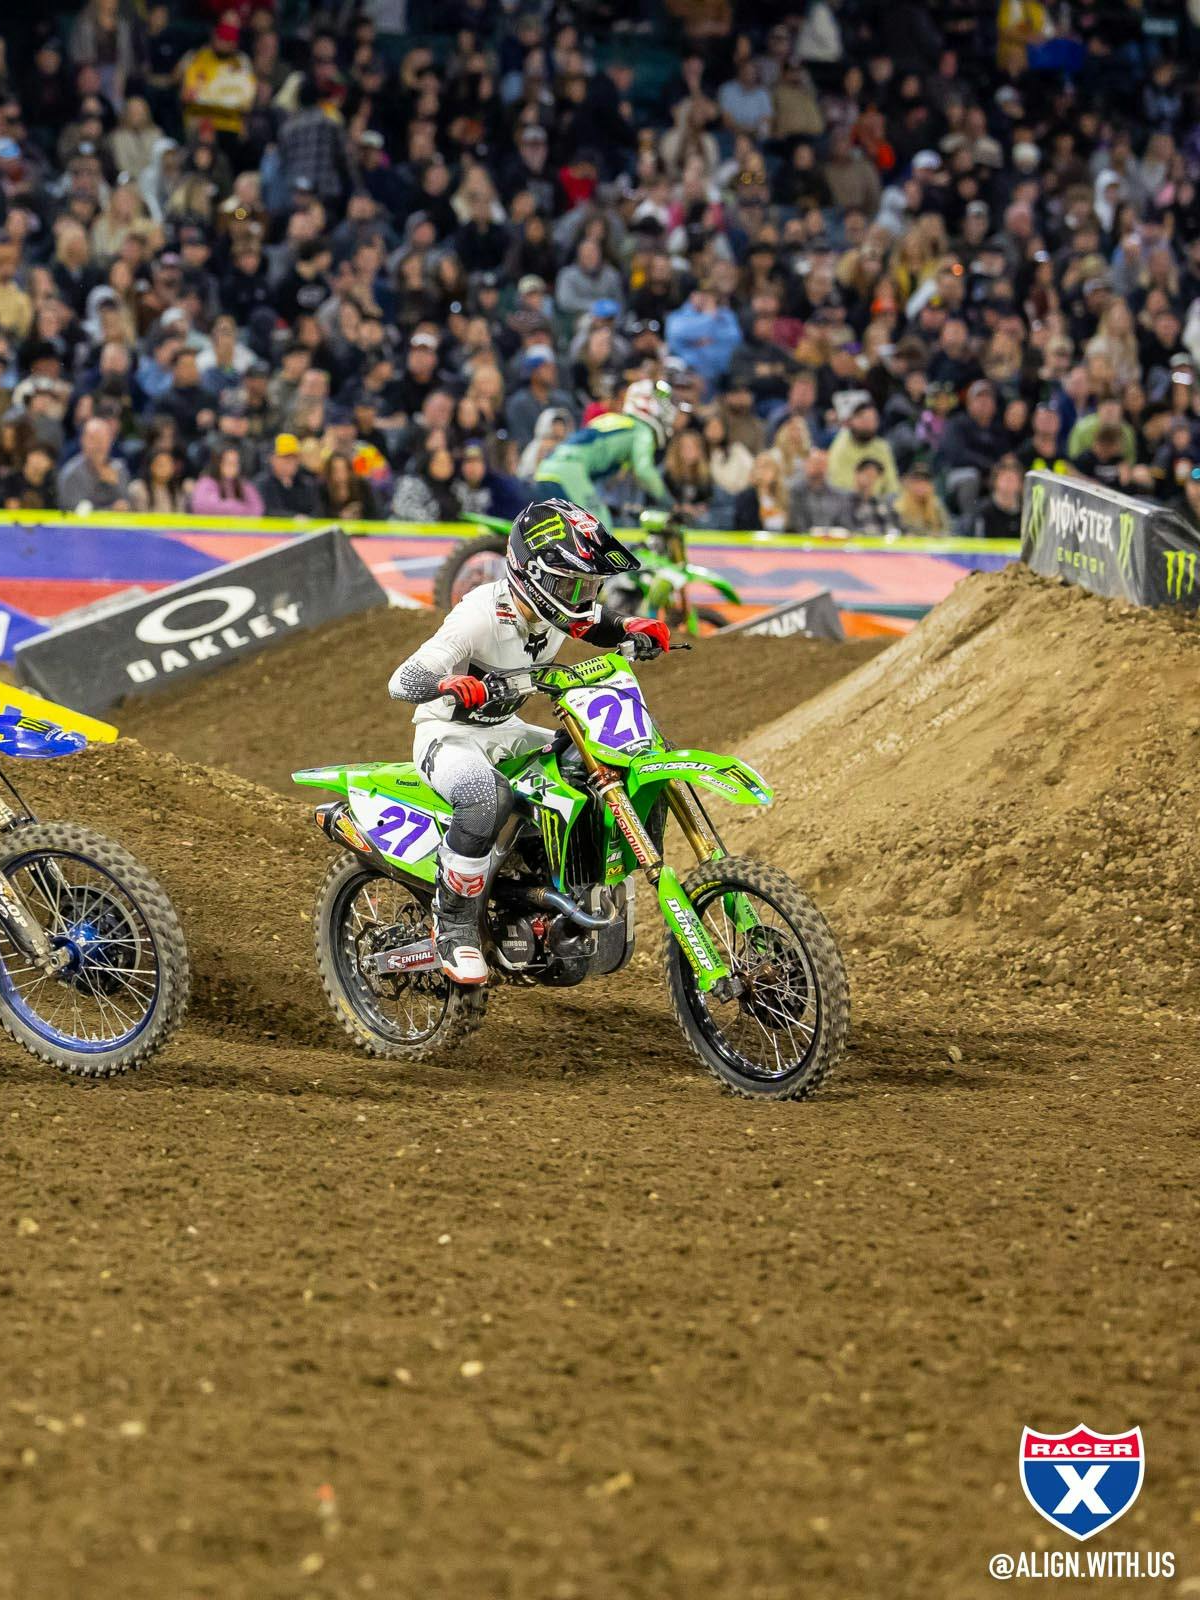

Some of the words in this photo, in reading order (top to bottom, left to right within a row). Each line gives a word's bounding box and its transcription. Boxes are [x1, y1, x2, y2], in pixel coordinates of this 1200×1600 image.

[1050, 494, 1115, 553] MONSTER
[523, 580, 557, 615] MONSTER
[125, 601, 304, 685] OAKLEY
[587, 686, 648, 748] 27
[519, 769, 557, 797] KX
[639, 762, 661, 774] PRO
[663, 761, 715, 772] CIRCUIT
[367, 805, 432, 858] 27
[618, 817, 647, 864] SHOWA
[665, 898, 714, 971] DUNLOP
[692, 918, 721, 968] Kawasaki
